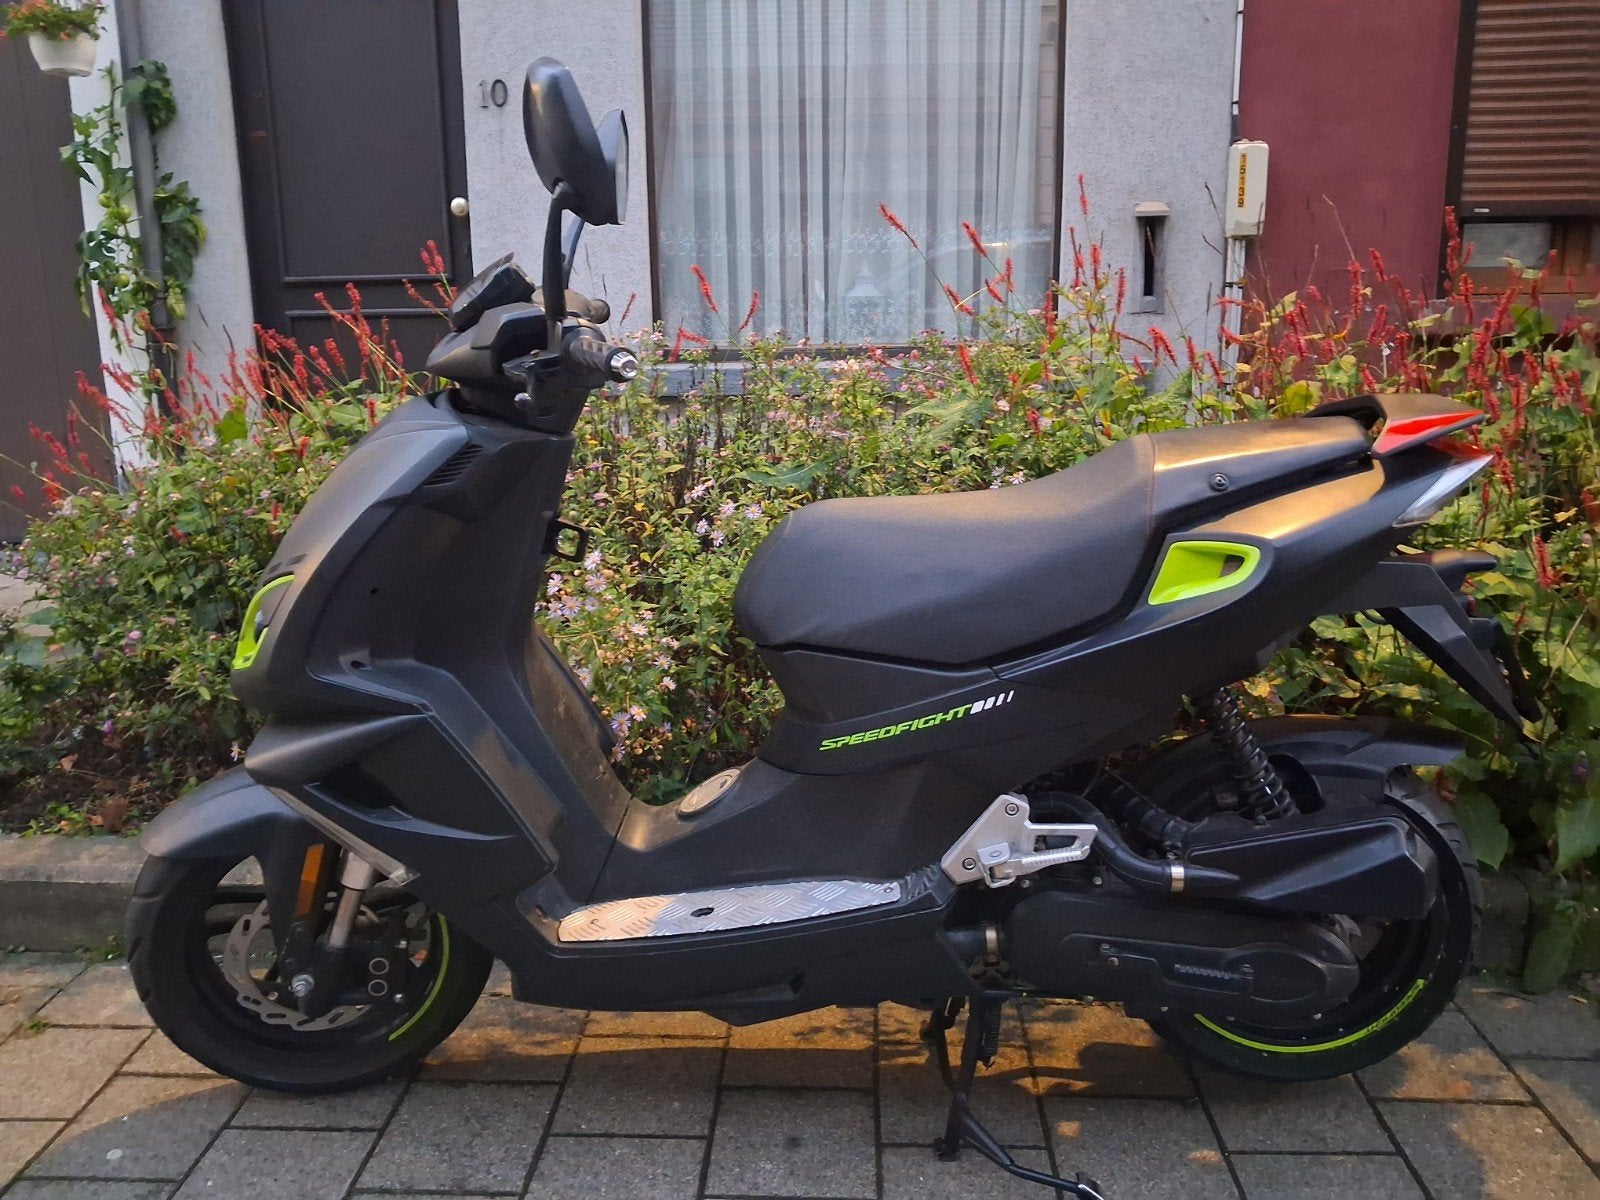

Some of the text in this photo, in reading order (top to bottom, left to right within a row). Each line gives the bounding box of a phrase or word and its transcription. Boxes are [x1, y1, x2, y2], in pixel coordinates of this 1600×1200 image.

[479, 79, 508, 108] 10
[1237, 153, 1247, 208] 15139
[819, 703, 972, 750] SPEEDFIGHT
